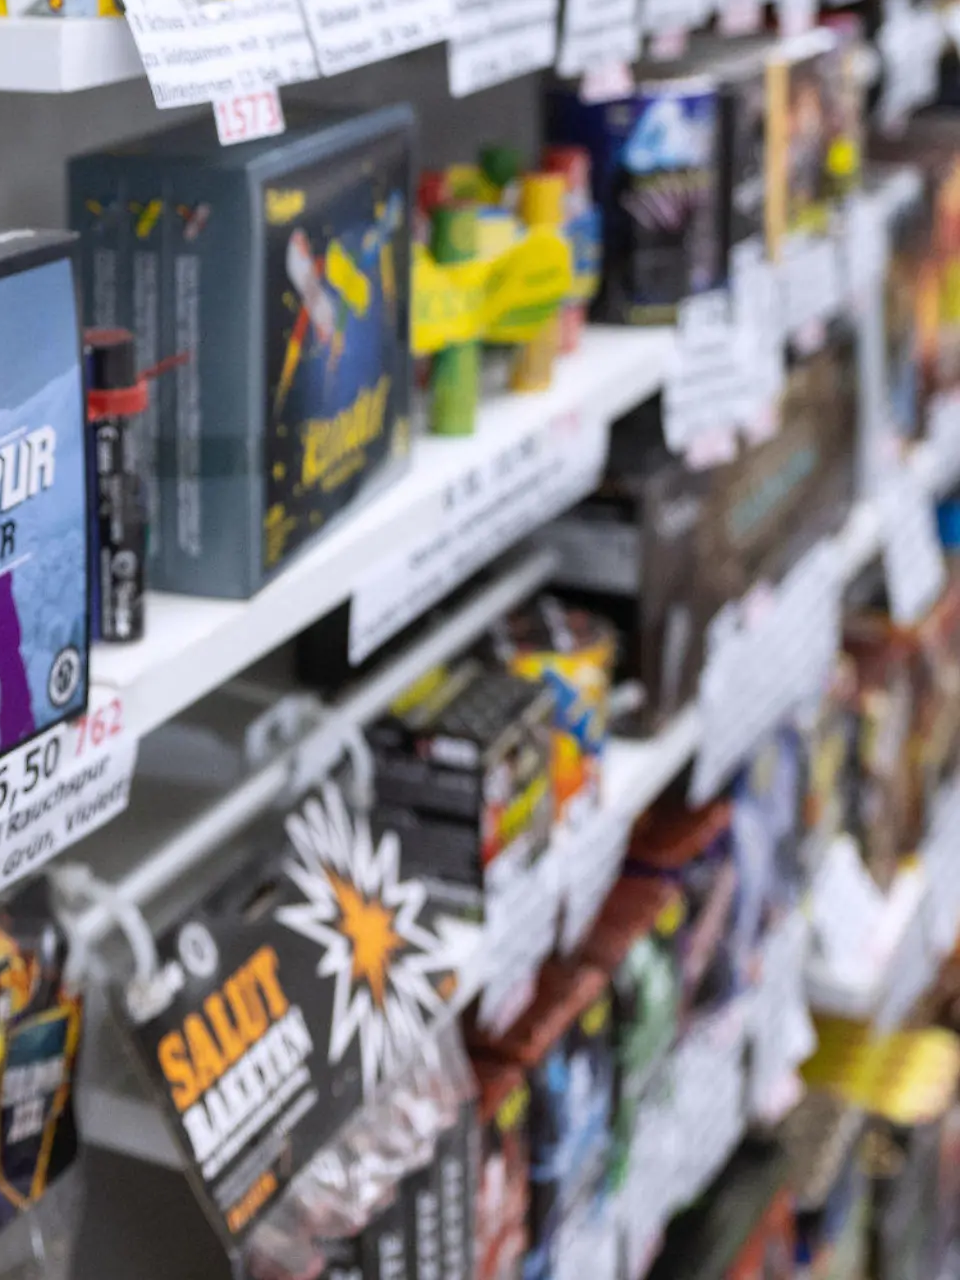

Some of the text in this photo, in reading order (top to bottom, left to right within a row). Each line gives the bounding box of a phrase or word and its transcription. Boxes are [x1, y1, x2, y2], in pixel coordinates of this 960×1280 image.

[74, 698, 125, 757] 762
[5, 752, 114, 837] Rauchspur
[157, 945, 290, 1113] SALUT
